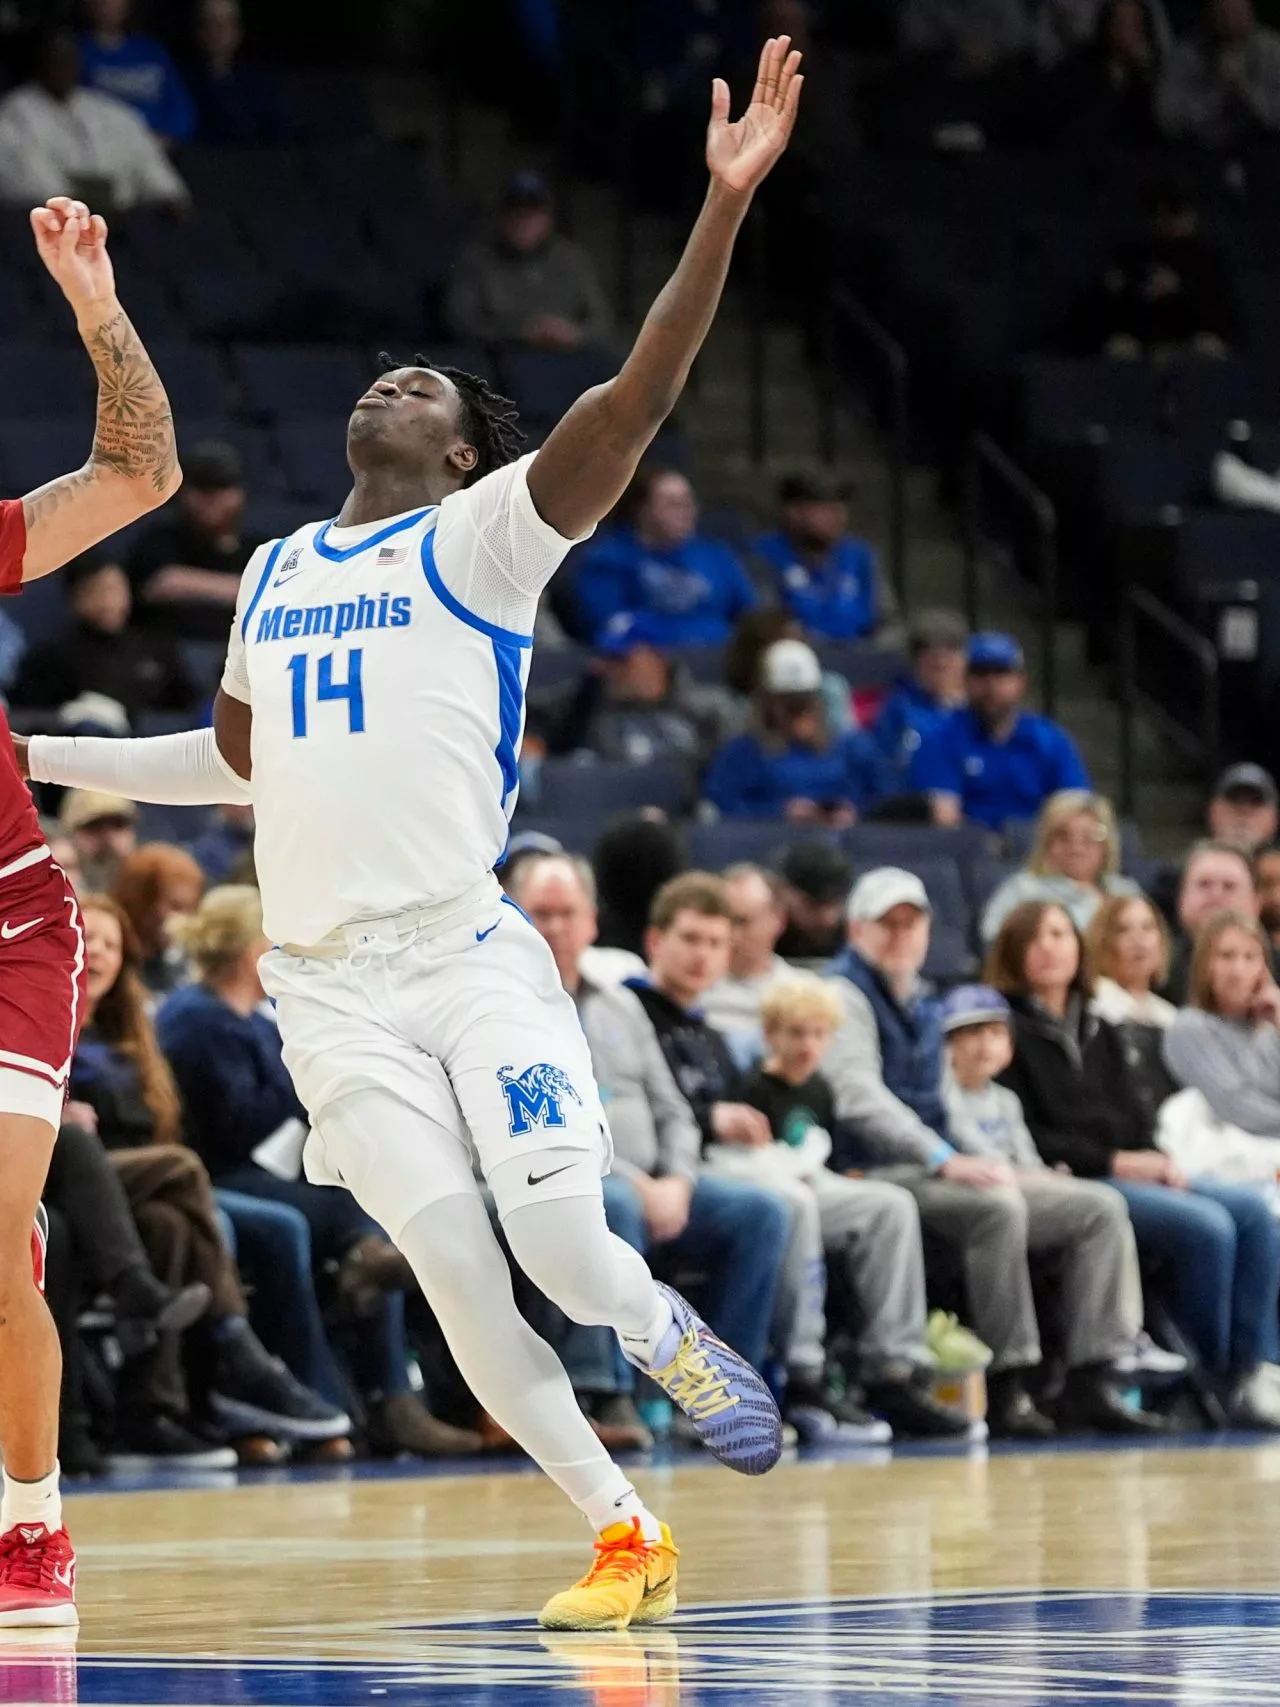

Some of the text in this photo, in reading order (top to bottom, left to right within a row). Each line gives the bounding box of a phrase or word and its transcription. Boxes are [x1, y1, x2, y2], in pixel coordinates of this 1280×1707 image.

[255, 592, 412, 644] Memphis
[285, 648, 366, 739] 14
[501, 1080, 566, 1137] M
